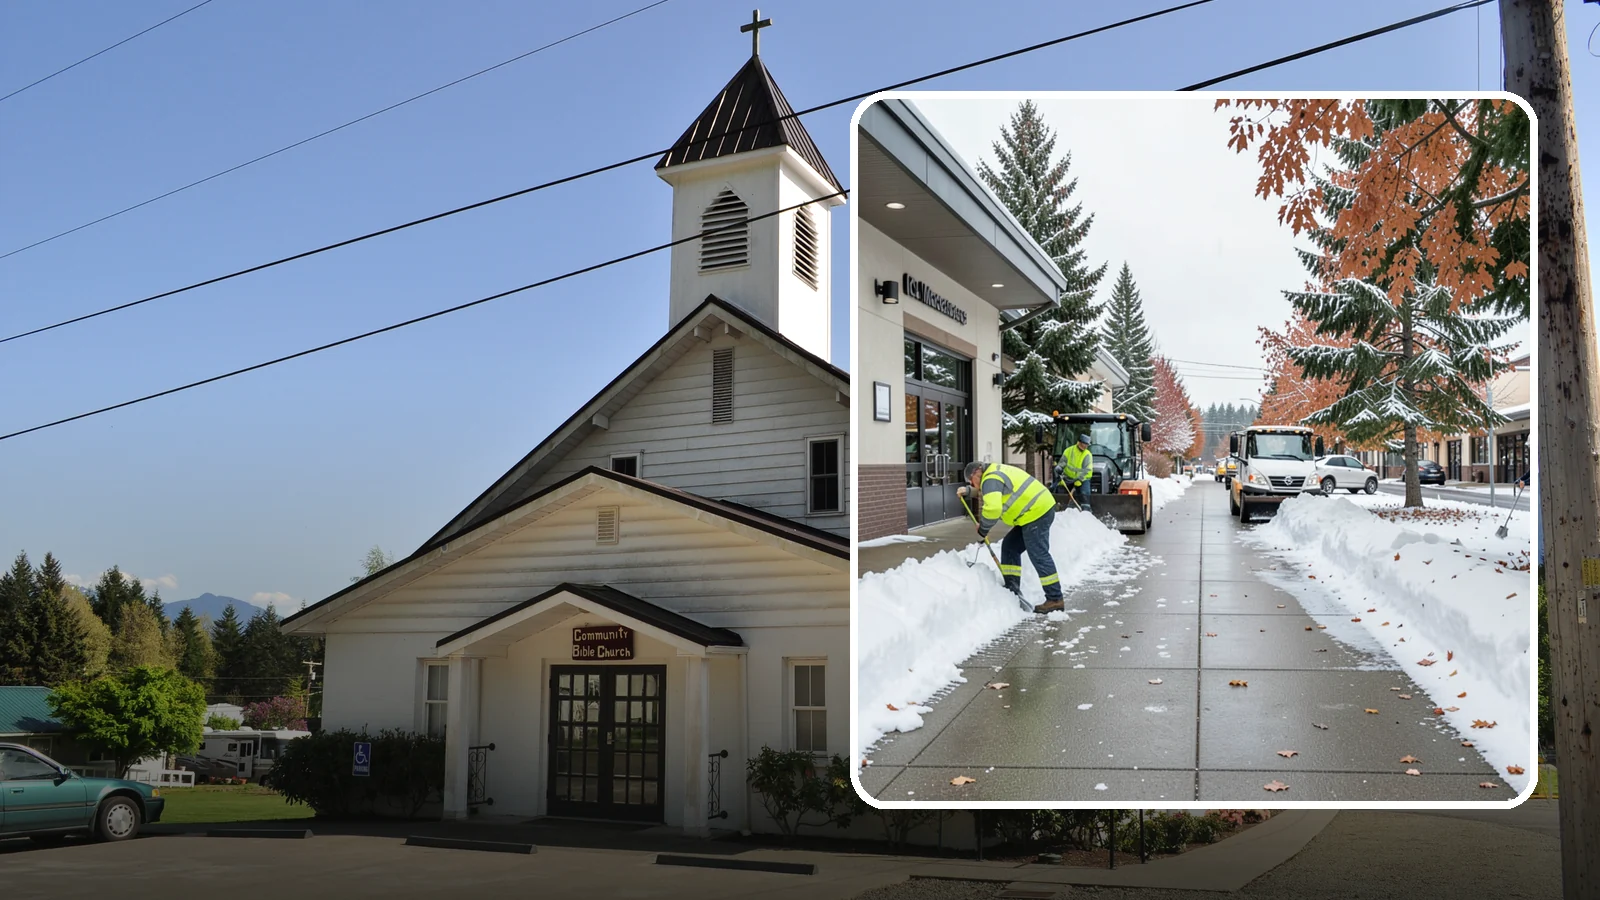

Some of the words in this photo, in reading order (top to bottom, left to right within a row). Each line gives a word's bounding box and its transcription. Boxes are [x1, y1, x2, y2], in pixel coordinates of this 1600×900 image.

[574, 627, 628, 641] Community
[573, 644, 595, 657] Bible
[597, 645, 631, 658] Church
